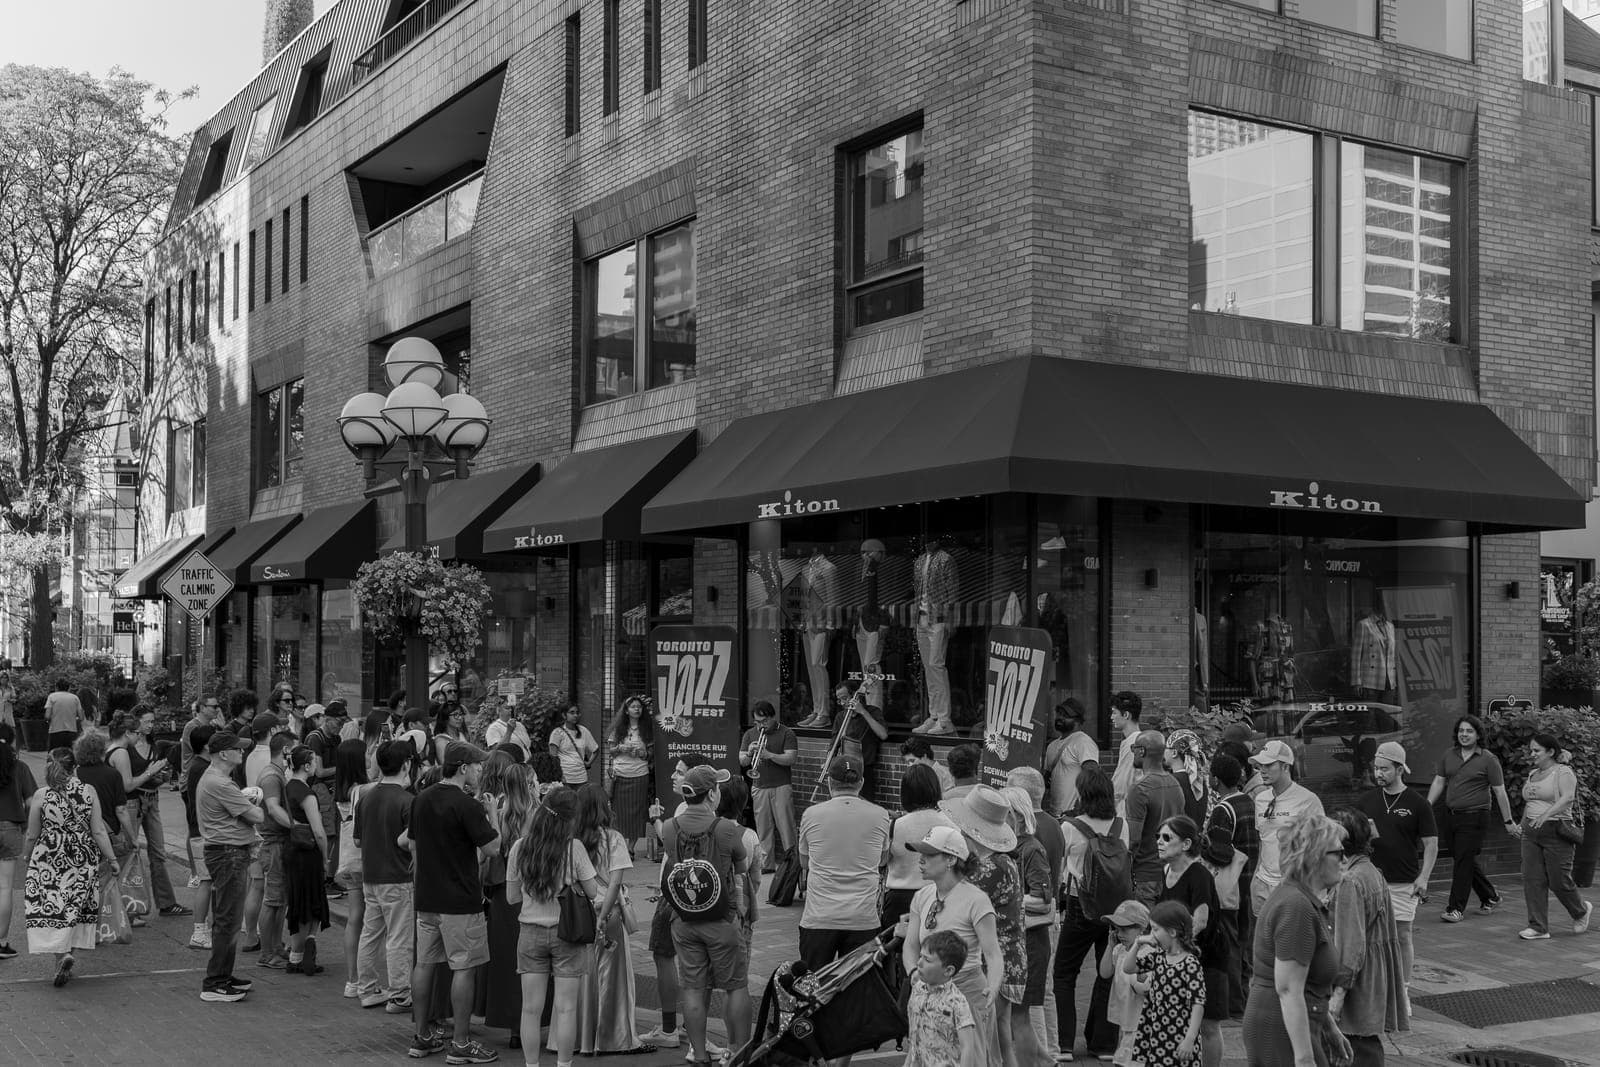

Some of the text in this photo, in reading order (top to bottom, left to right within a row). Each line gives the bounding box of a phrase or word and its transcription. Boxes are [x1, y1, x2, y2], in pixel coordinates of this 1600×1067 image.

[757, 489, 841, 519] Kiton
[1269, 481, 1384, 513] Kiton
[513, 526, 565, 549] Kiton
[180, 568, 215, 580] TRAFFIC
[180, 583, 216, 596] CALMING
[187, 599, 209, 611] ZONE
[656, 640, 712, 652] TORONTO
[990, 640, 1031, 661] TORONTO
[656, 640, 732, 717] JAZZ
[847, 671, 897, 681] Kion
[986, 648, 1046, 737] JAZZ
[1308, 696, 1369, 712] Kiton
[694, 708, 725, 718] FEST
[1010, 728, 1033, 744] FEST
[667, 742, 701, 751] SÉANCES
[712, 744, 728, 752] RUE
[712, 752, 728, 760] par
